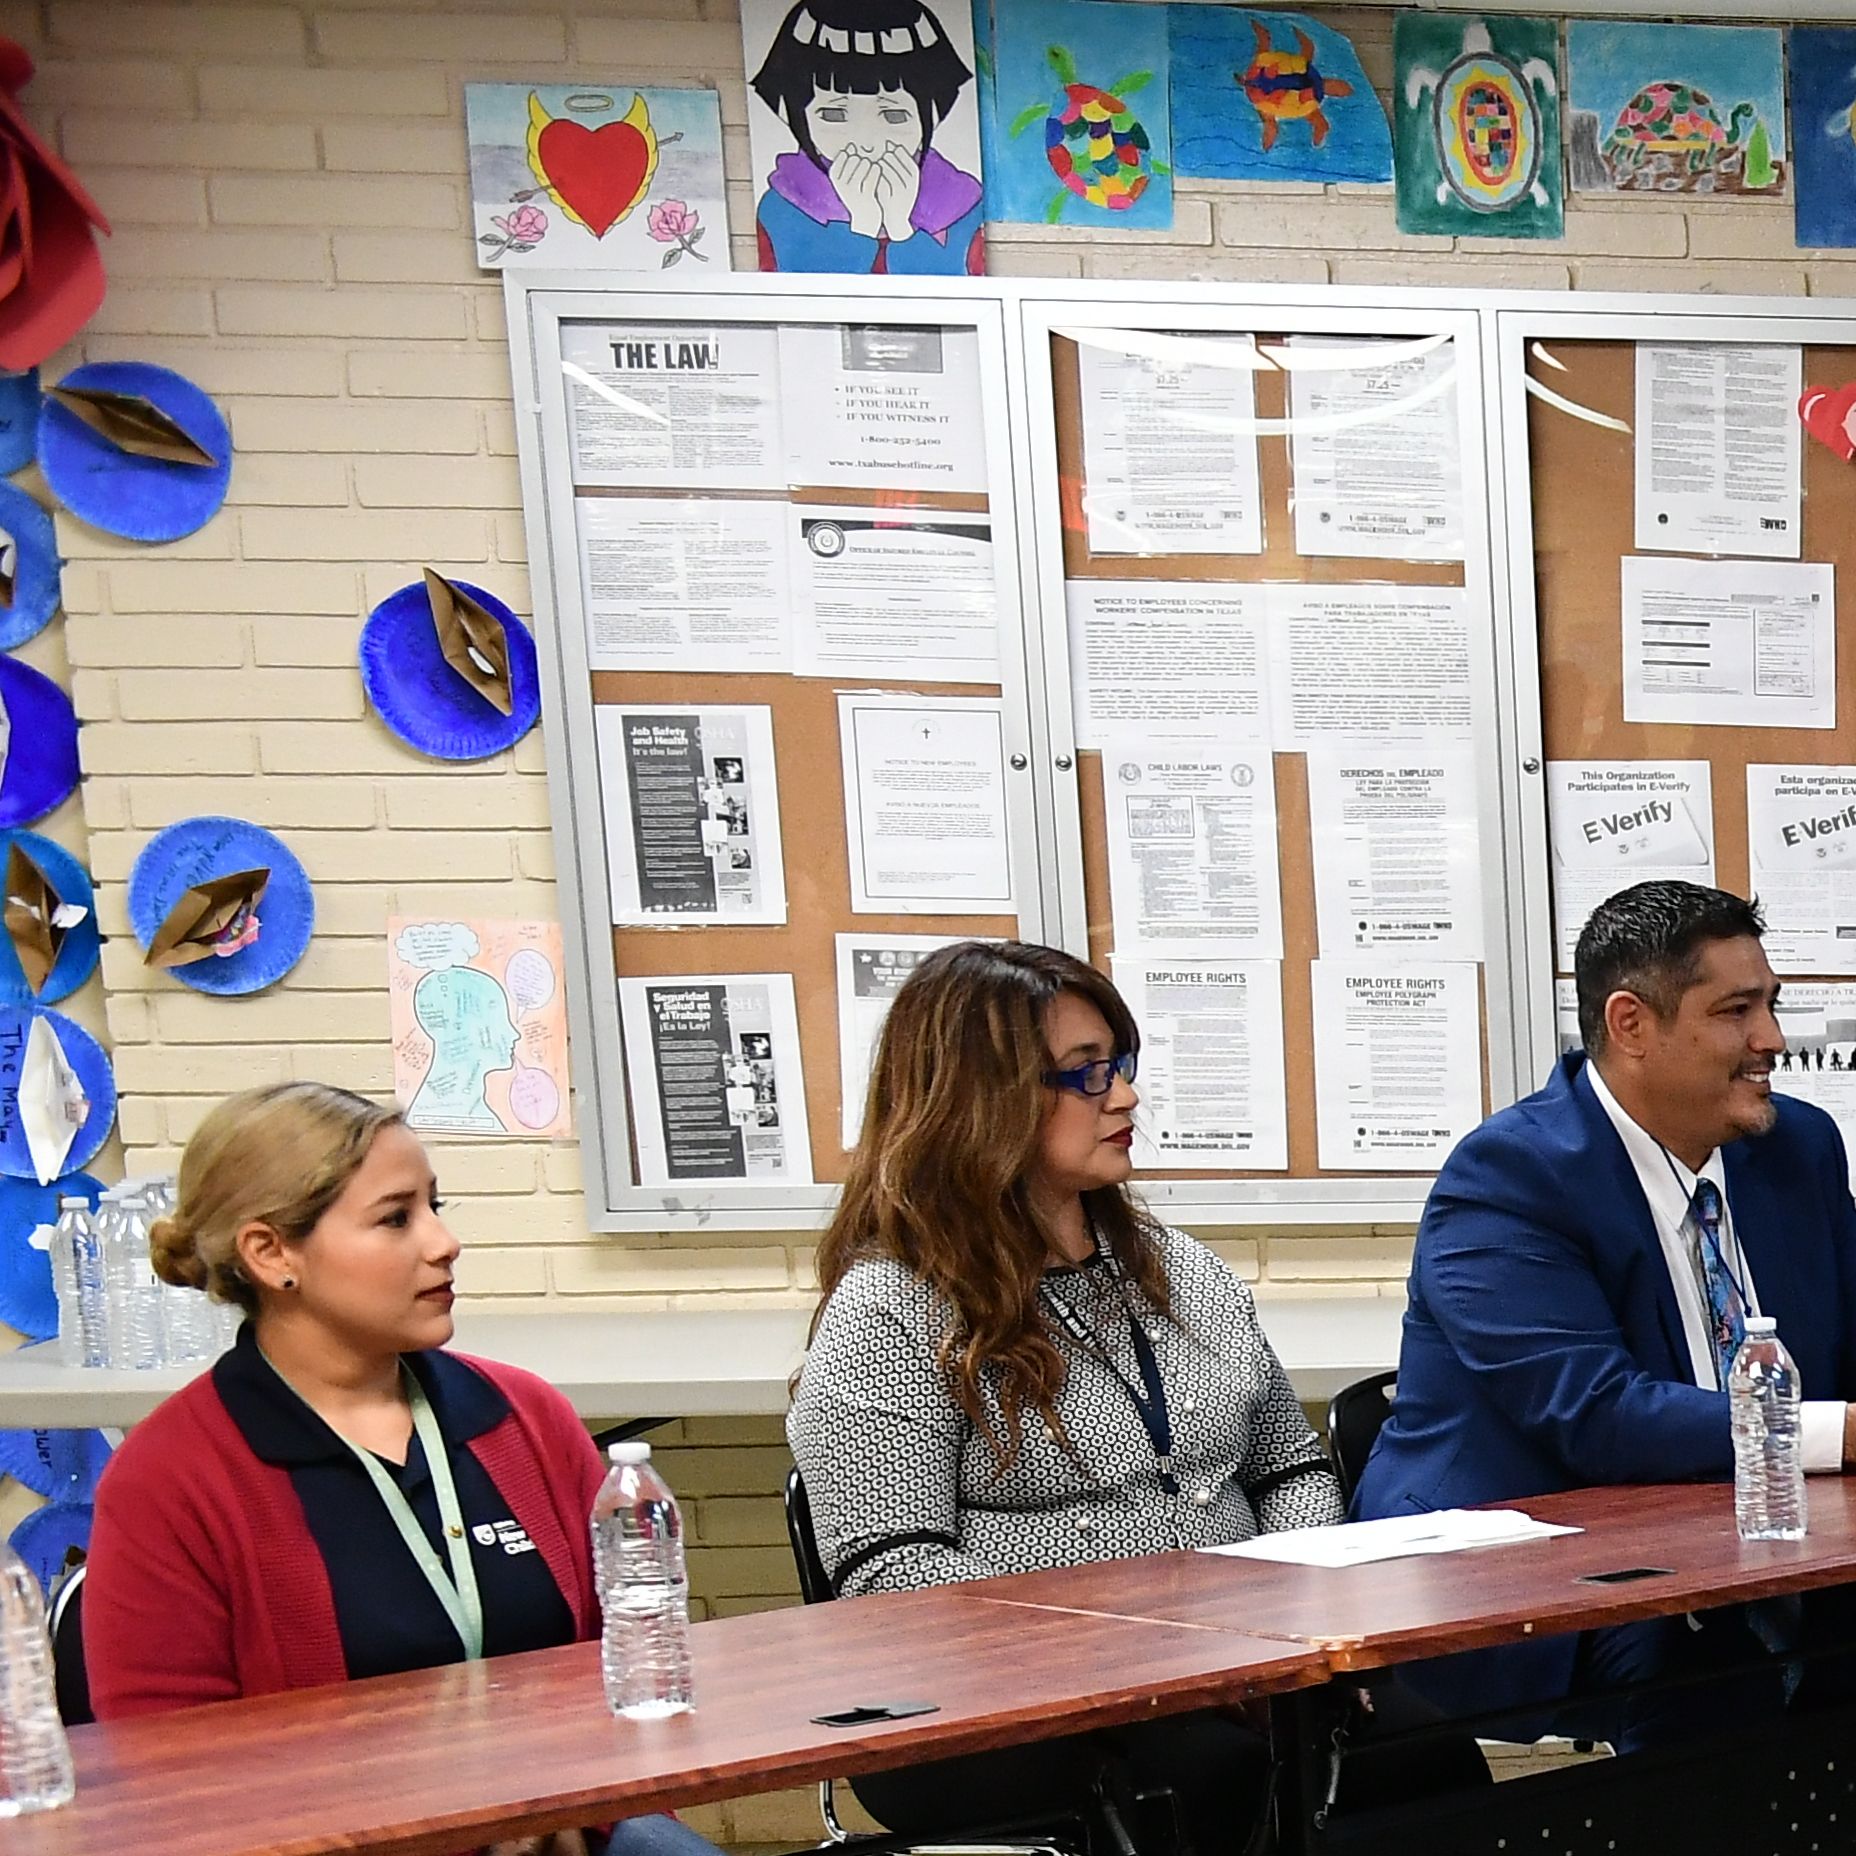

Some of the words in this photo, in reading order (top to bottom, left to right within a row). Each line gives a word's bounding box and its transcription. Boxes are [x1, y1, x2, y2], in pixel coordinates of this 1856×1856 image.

[609, 343, 658, 369] THE
[846, 399, 856, 407] IF
[860, 400, 881, 408] YOU
[885, 400, 917, 409] HEAR
[860, 413, 882, 421] YOU
[886, 414, 937, 423] WITNESS
[828, 460, 954, 472] www.txabusehotline.org
[630, 726, 650, 736] Job
[652, 726, 686, 738] Safety
[632, 736, 653, 745] and
[655, 736, 689, 746] Health
[649, 748, 666, 756] the
[1340, 769, 1385, 778] DERECHOS
[1398, 769, 1445, 778] EMPLEADO
[1581, 771, 1603, 780] This
[1606, 771, 1676, 782] Organization
[1780, 775, 1803, 784] Esta
[1567, 782, 1634, 792] Participates
[1649, 782, 1691, 792] E-Verify
[1775, 786, 1821, 796] participa
[1145, 972, 1203, 982] EMPLOYEE
[1206, 973, 1247, 984] RIGHTS
[1346, 977, 1402, 988] EMPLOYEE
[1406, 978, 1445, 989] RIGHTS
[653, 991, 710, 1003] Seguridad
[1395, 991, 1437, 999] POLYGRAPH
[663, 1001, 695, 1010] Salud
[659, 1011, 670, 1020] el
[671, 1011, 711, 1021] Trabajo
[678, 1022, 688, 1031] la
[2, 1023, 23, 1073] The
[1065, 1317, 1087, 1340] and
